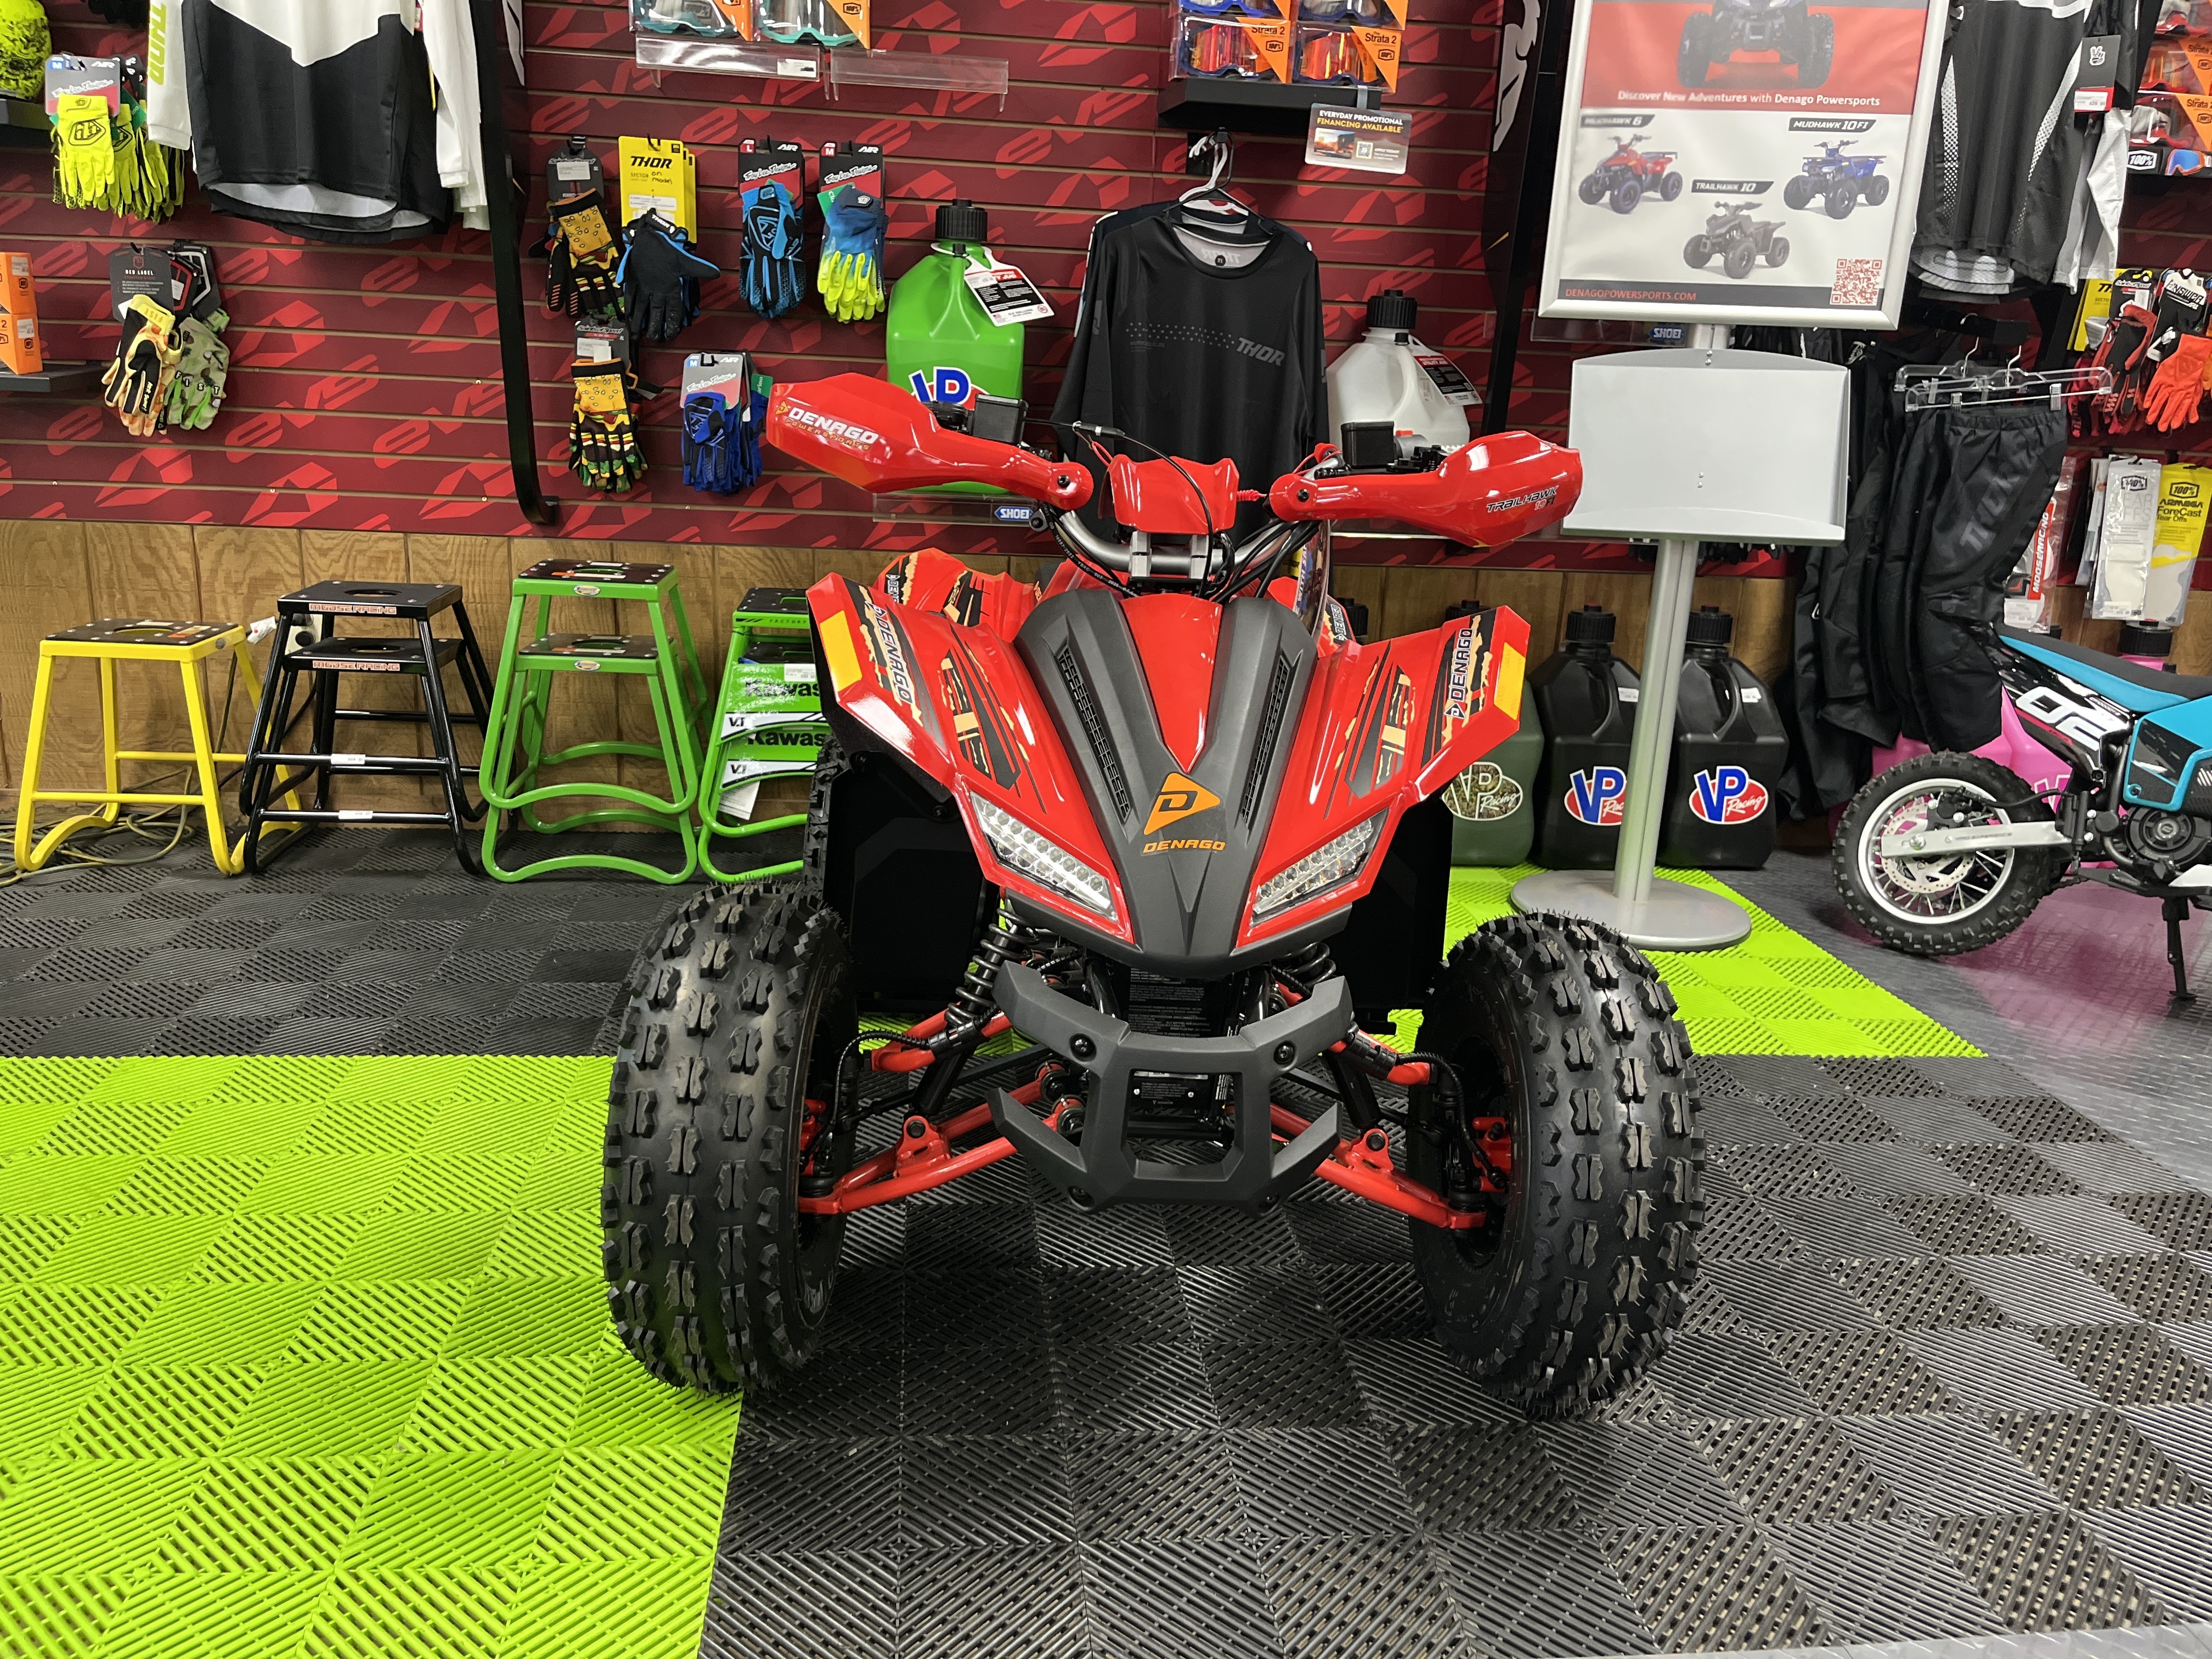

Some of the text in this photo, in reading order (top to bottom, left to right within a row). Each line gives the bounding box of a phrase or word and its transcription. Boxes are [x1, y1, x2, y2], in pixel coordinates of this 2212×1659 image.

[148, 3, 166, 85] THOR
[1365, 33, 1397, 44] Strata 2
[1617, 89, 1880, 107] Discover New Adventures with Denago Powersports
[2187, 99, 2209, 109] Strata
[1317, 117, 1361, 129] FINANCING
[1319, 110, 1403, 126] EVERYDAY PROMOTIONAL
[1633, 116, 1643, 126] 6
[1793, 121, 1842, 129] MUDHAWK
[630, 156, 673, 169] THOR
[2129, 154, 2154, 166] 100%
[1696, 183, 1738, 191] TRAILHAWK
[1565, 288, 1696, 301] DENAGOPOWERSPORTS.COM
[2, 320, 8, 328] 2
[1652, 328, 1682, 340] SHOEI
[1237, 337, 1285, 367] THOR
[788, 405, 879, 444] DENAGO
[785, 419, 871, 452] POWERSPORTS
[2174, 486, 2195, 495] 100%
[1000, 508, 1030, 519] SHOEI
[2158, 506, 2202, 517] ForeCast
[353, 605, 397, 615] RACING
[1330, 604, 1347, 635] DENAGO
[876, 614, 913, 704] DENAGO
[1449, 628, 1474, 702] DENAGO
[356, 662, 400, 672] RACING
[1450, 762, 1503, 820] VP
[1569, 765, 1627, 825] VP
[1693, 765, 1749, 824] VP
[1480, 791, 1522, 811] Racing
[1726, 794, 1768, 815] Racing
[1143, 839, 1226, 854] DENAGO
